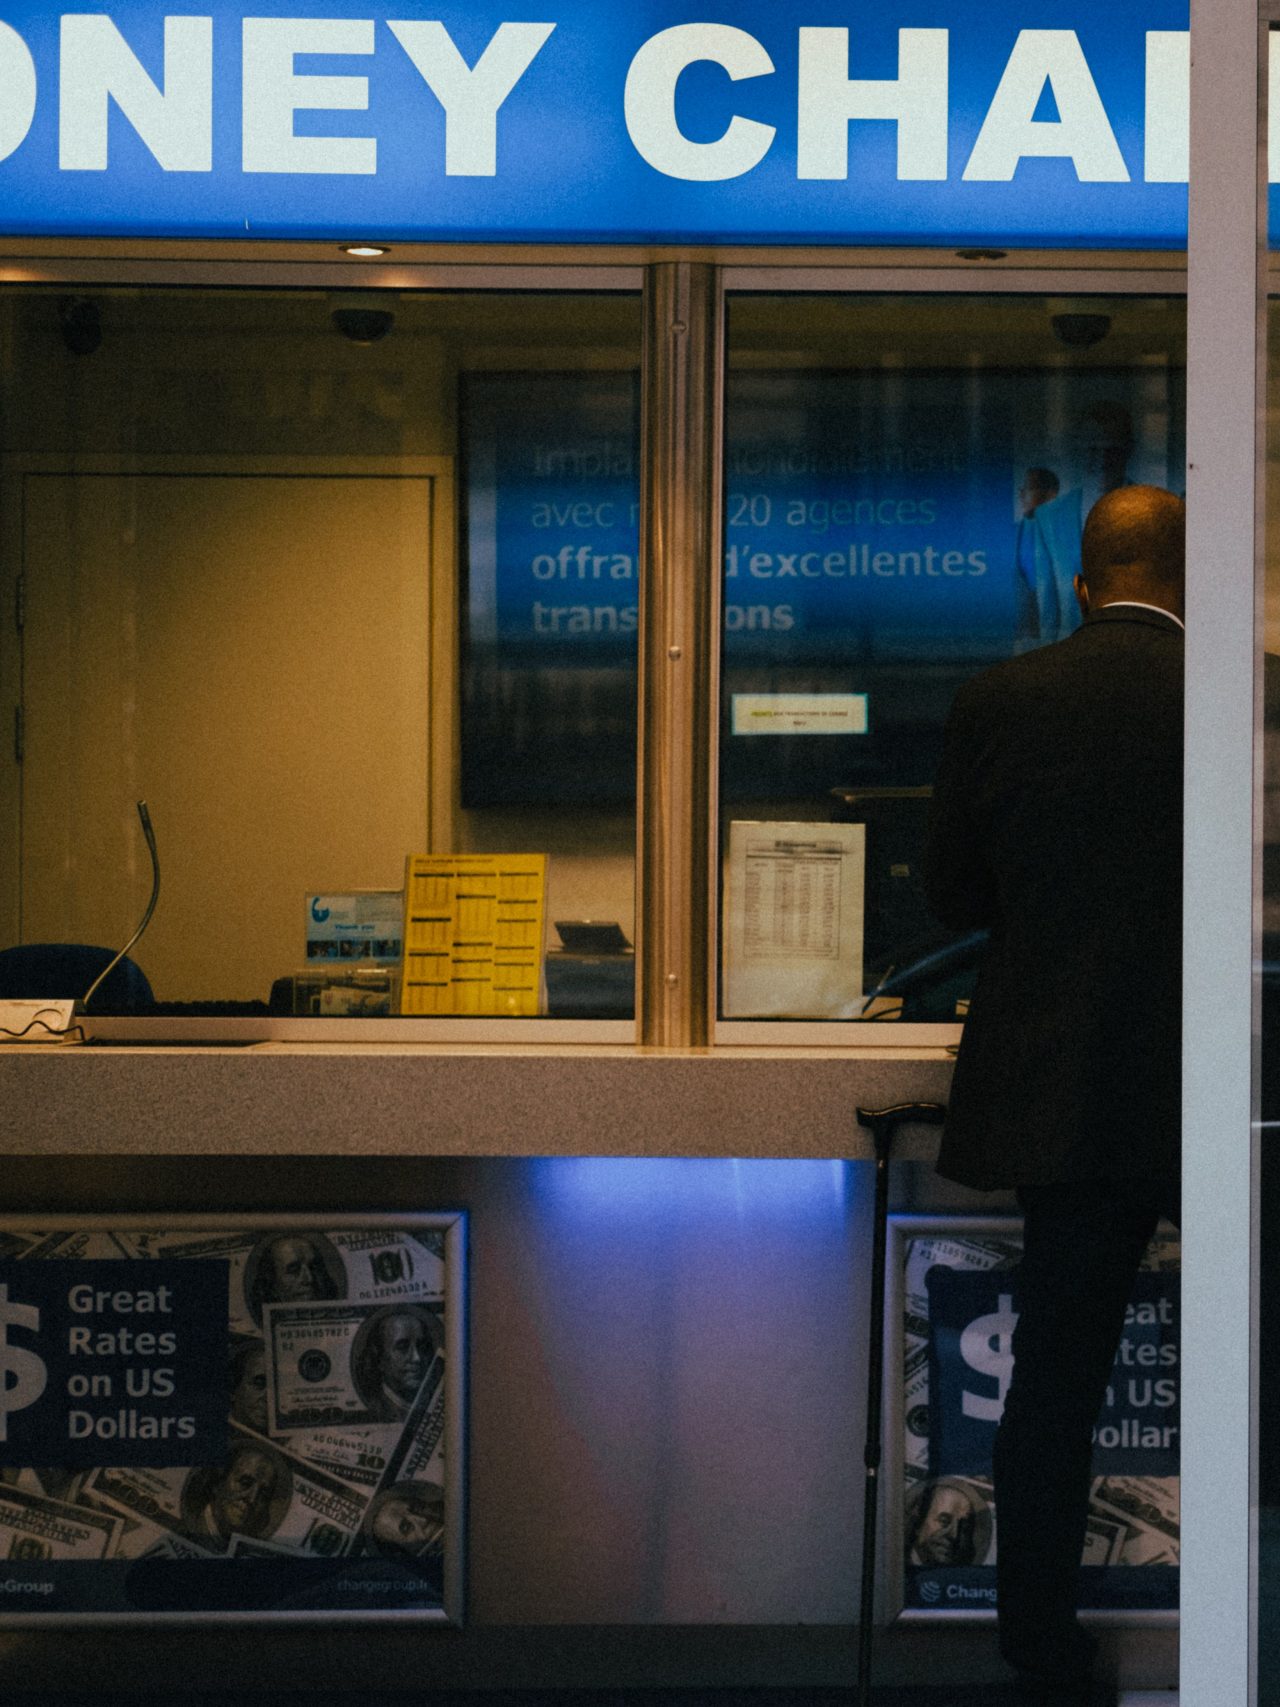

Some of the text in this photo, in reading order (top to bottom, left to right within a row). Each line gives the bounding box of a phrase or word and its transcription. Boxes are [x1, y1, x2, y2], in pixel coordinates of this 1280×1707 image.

[0, 14, 557, 176] NEY
[531, 501, 614, 527] avec
[786, 499, 937, 534] agences
[531, 545, 638, 580] offra
[68, 1285, 172, 1313] Great
[69, 1329, 177, 1356] Rates
[68, 1369, 175, 1398] on US
[1128, 1379, 1178, 1408] US
[69, 1410, 196, 1440] Dollars
[1091, 1418, 1178, 1449] ollar
